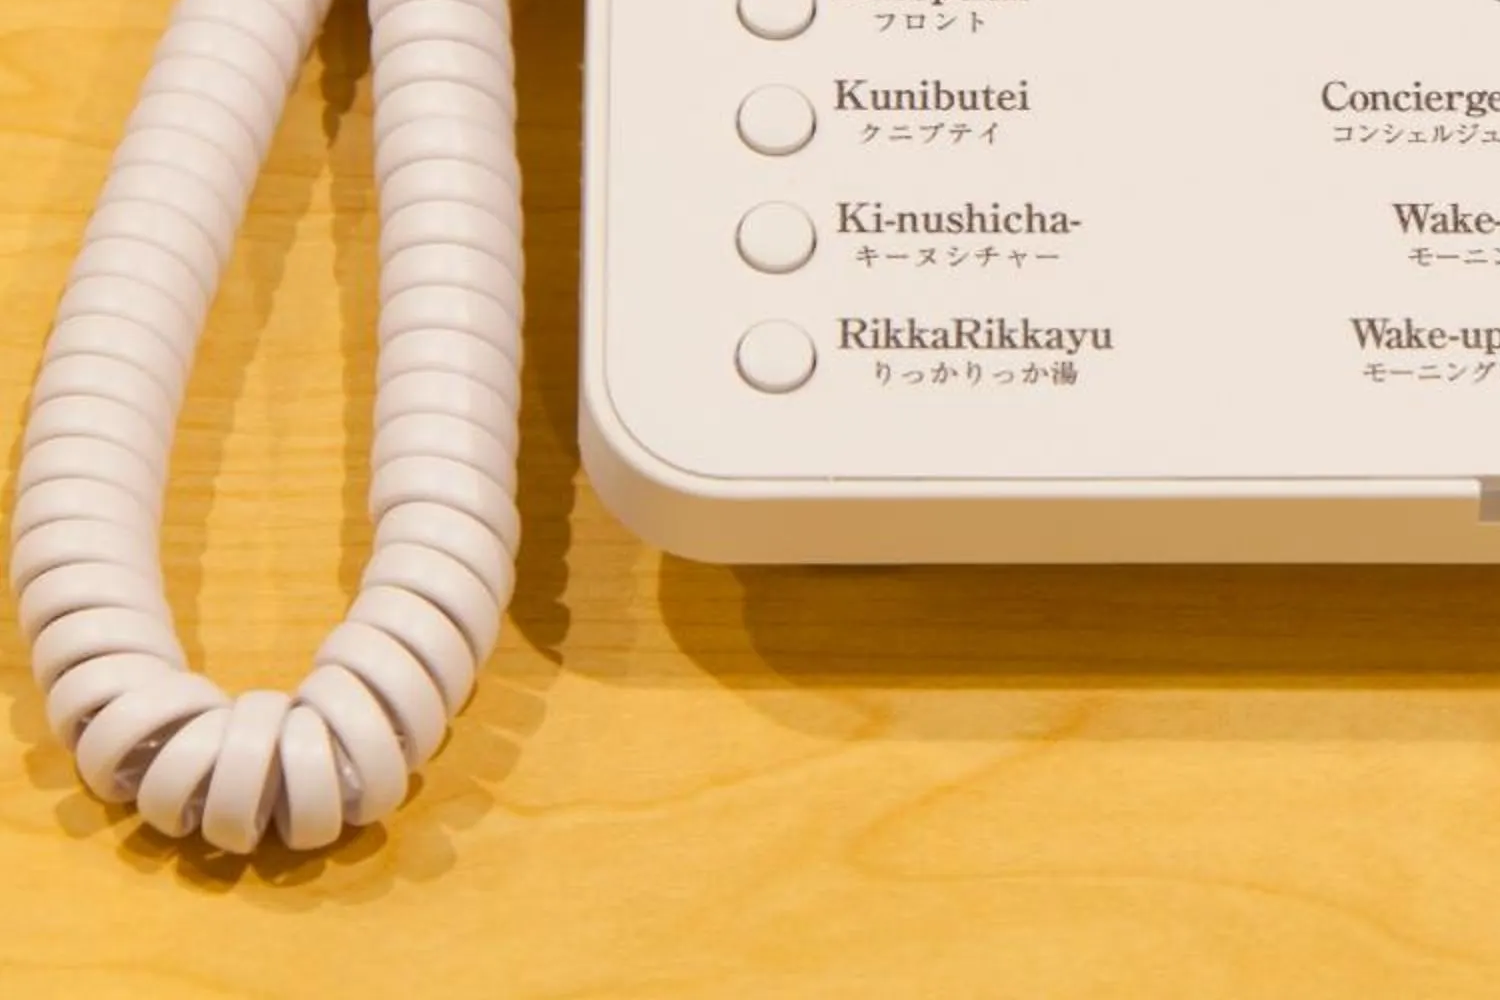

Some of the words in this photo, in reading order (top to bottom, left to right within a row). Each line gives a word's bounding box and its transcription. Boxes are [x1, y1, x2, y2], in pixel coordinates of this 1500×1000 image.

[874, 11, 985, 34] フロント
[834, 79, 1031, 112] Kunibutei
[837, 201, 1082, 235] Ki-nushicha-
[855, 244, 1060, 269] キーヌシチャー
[838, 317, 1114, 356] RikkaRikkayu
[875, 360, 1079, 386] りっかりっか湯
